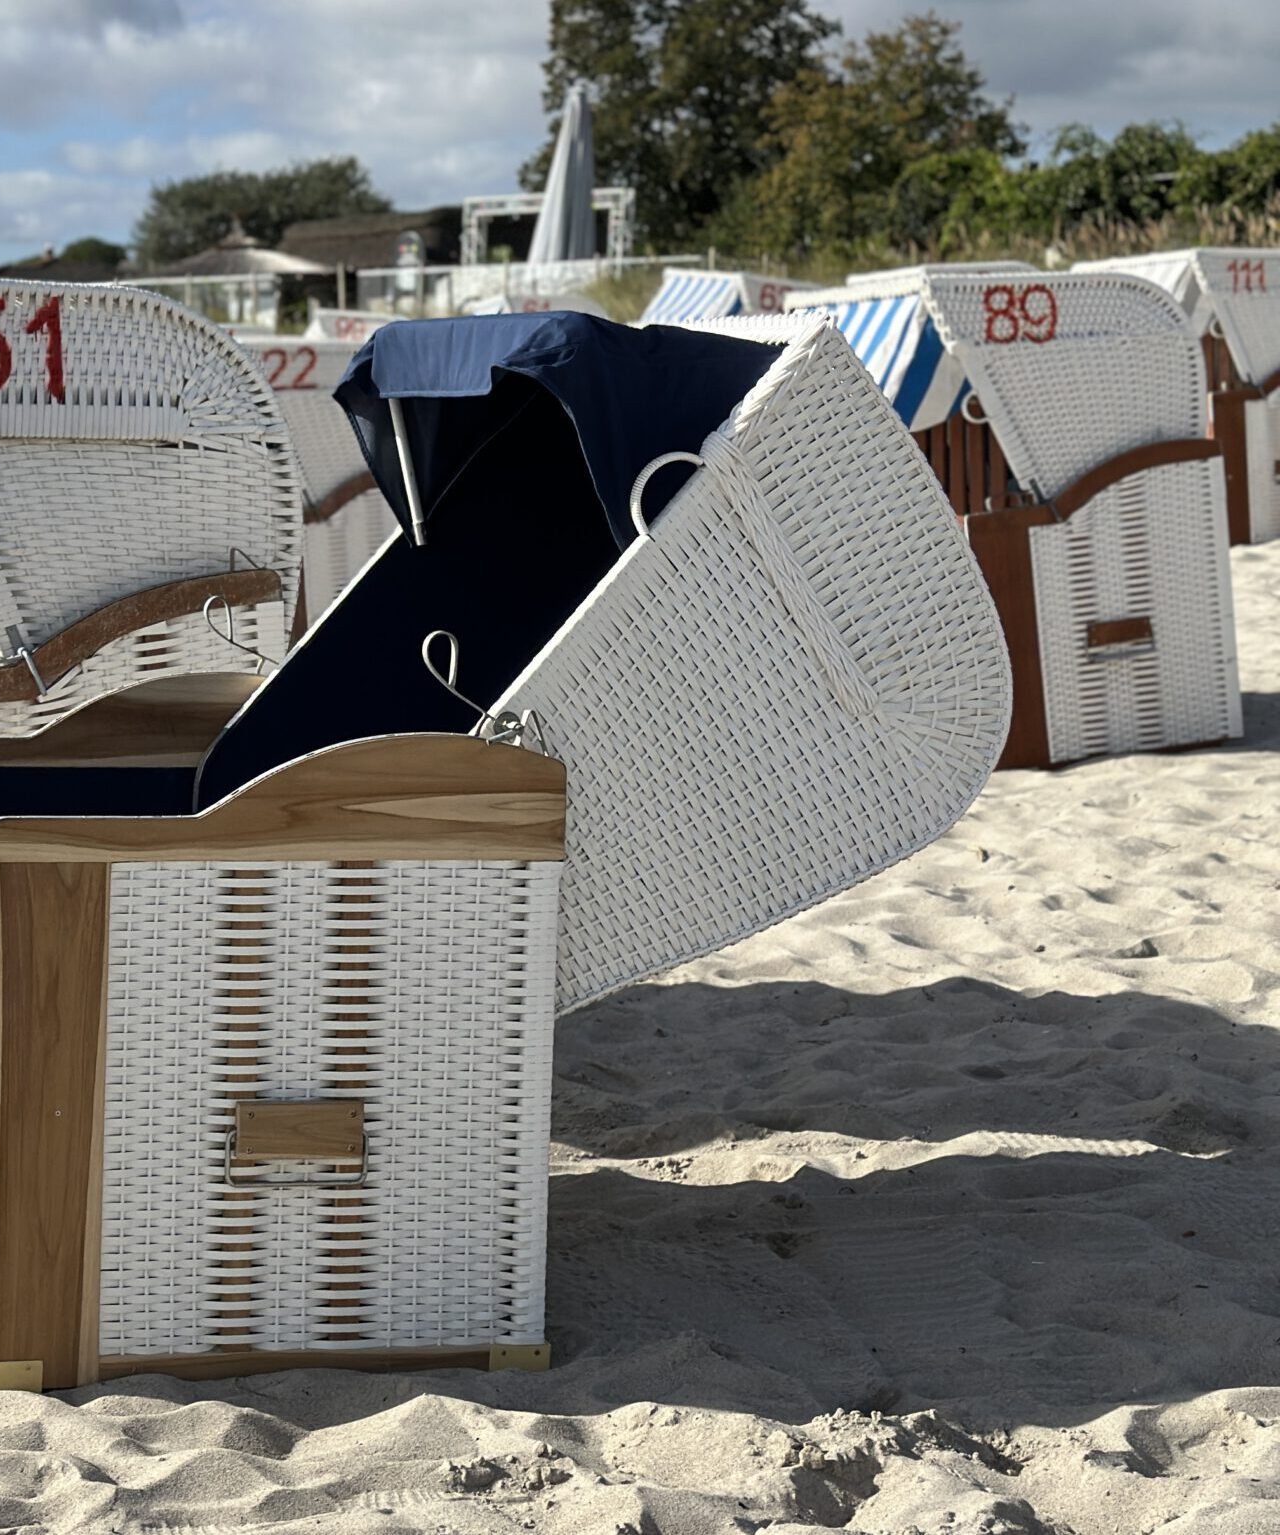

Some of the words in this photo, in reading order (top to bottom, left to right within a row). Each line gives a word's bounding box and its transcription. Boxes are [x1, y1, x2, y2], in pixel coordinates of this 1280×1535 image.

[1226, 258, 1267, 294] 111
[983, 283, 1058, 344] 89
[262, 346, 318, 391] 22
